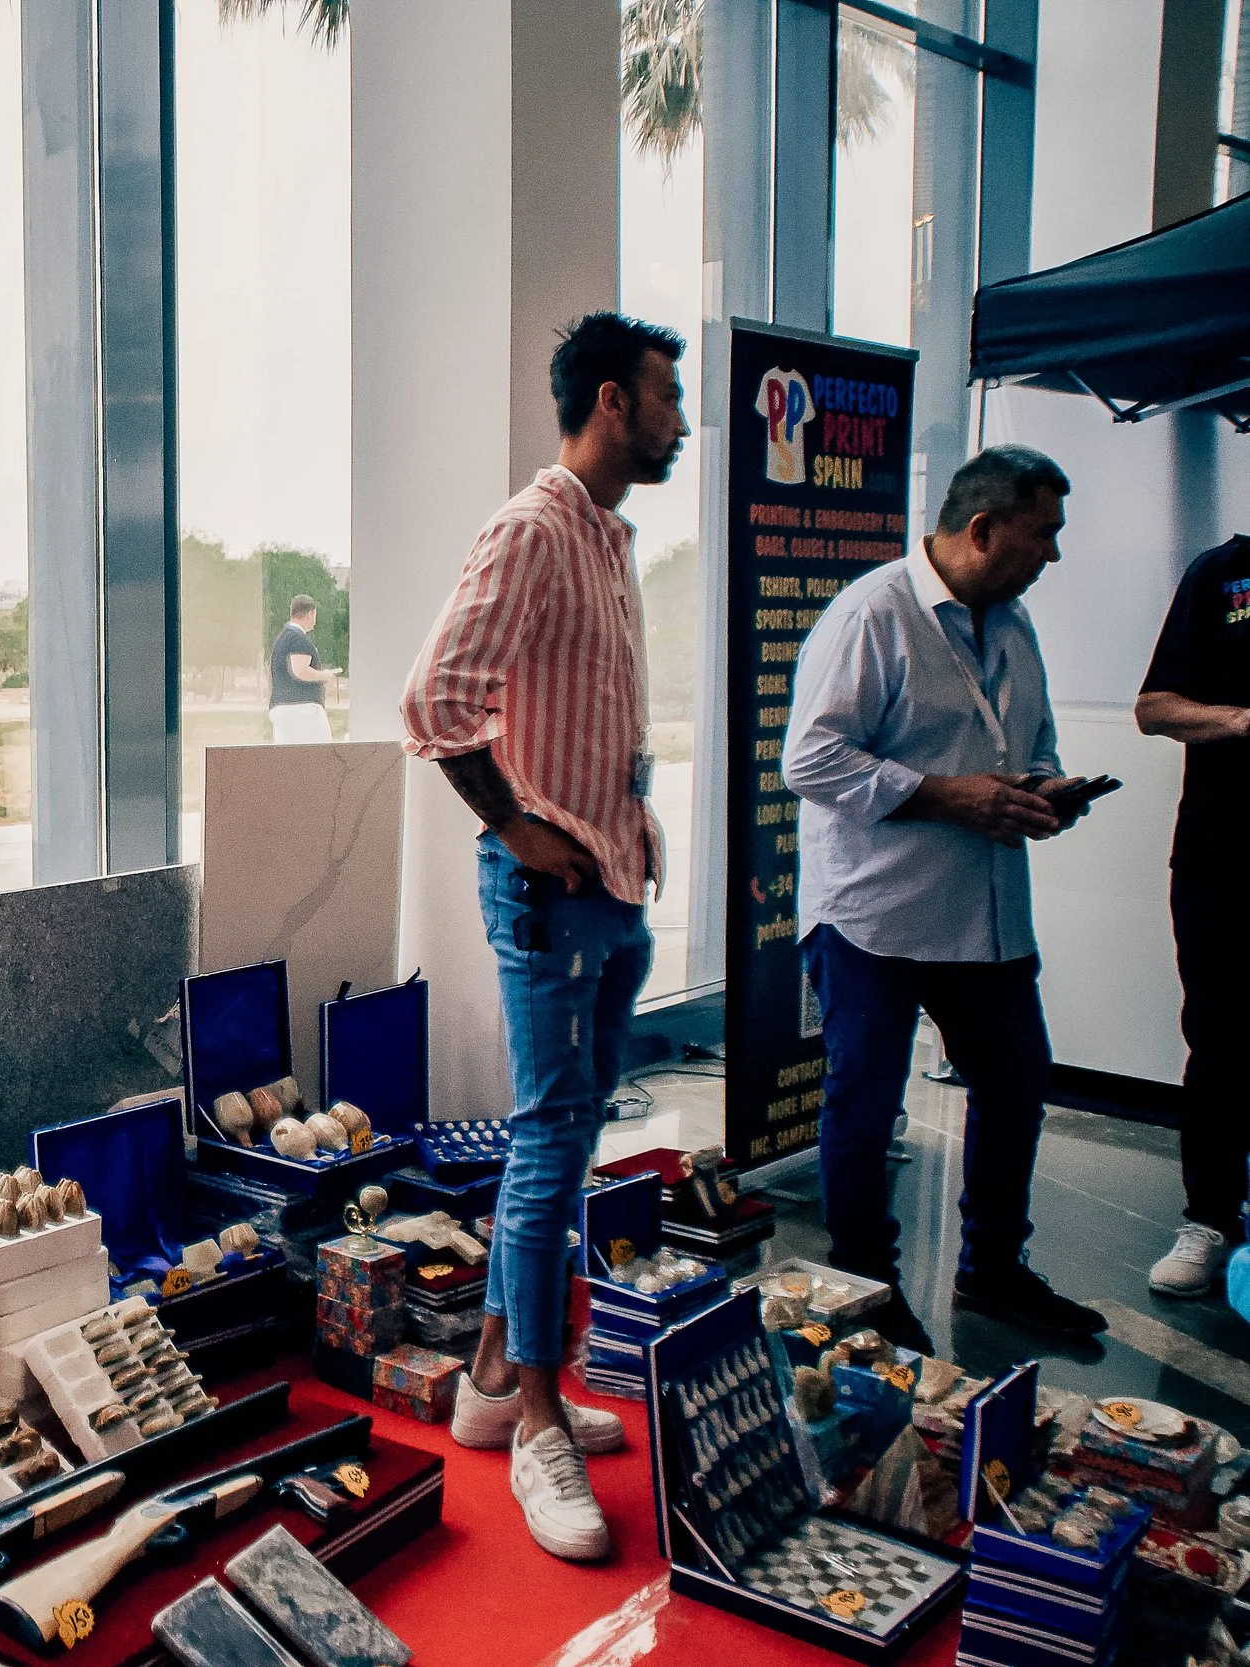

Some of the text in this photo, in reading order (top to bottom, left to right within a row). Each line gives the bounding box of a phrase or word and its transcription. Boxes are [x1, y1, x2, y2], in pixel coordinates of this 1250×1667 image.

[812, 372, 899, 418] PERFECTO
[822, 412, 887, 457] PRINT
[812, 453, 864, 490] SPAIN
[755, 609, 795, 631] SPORTS
[761, 641, 803, 663] BUSINE
[759, 706, 791, 728] MENU
